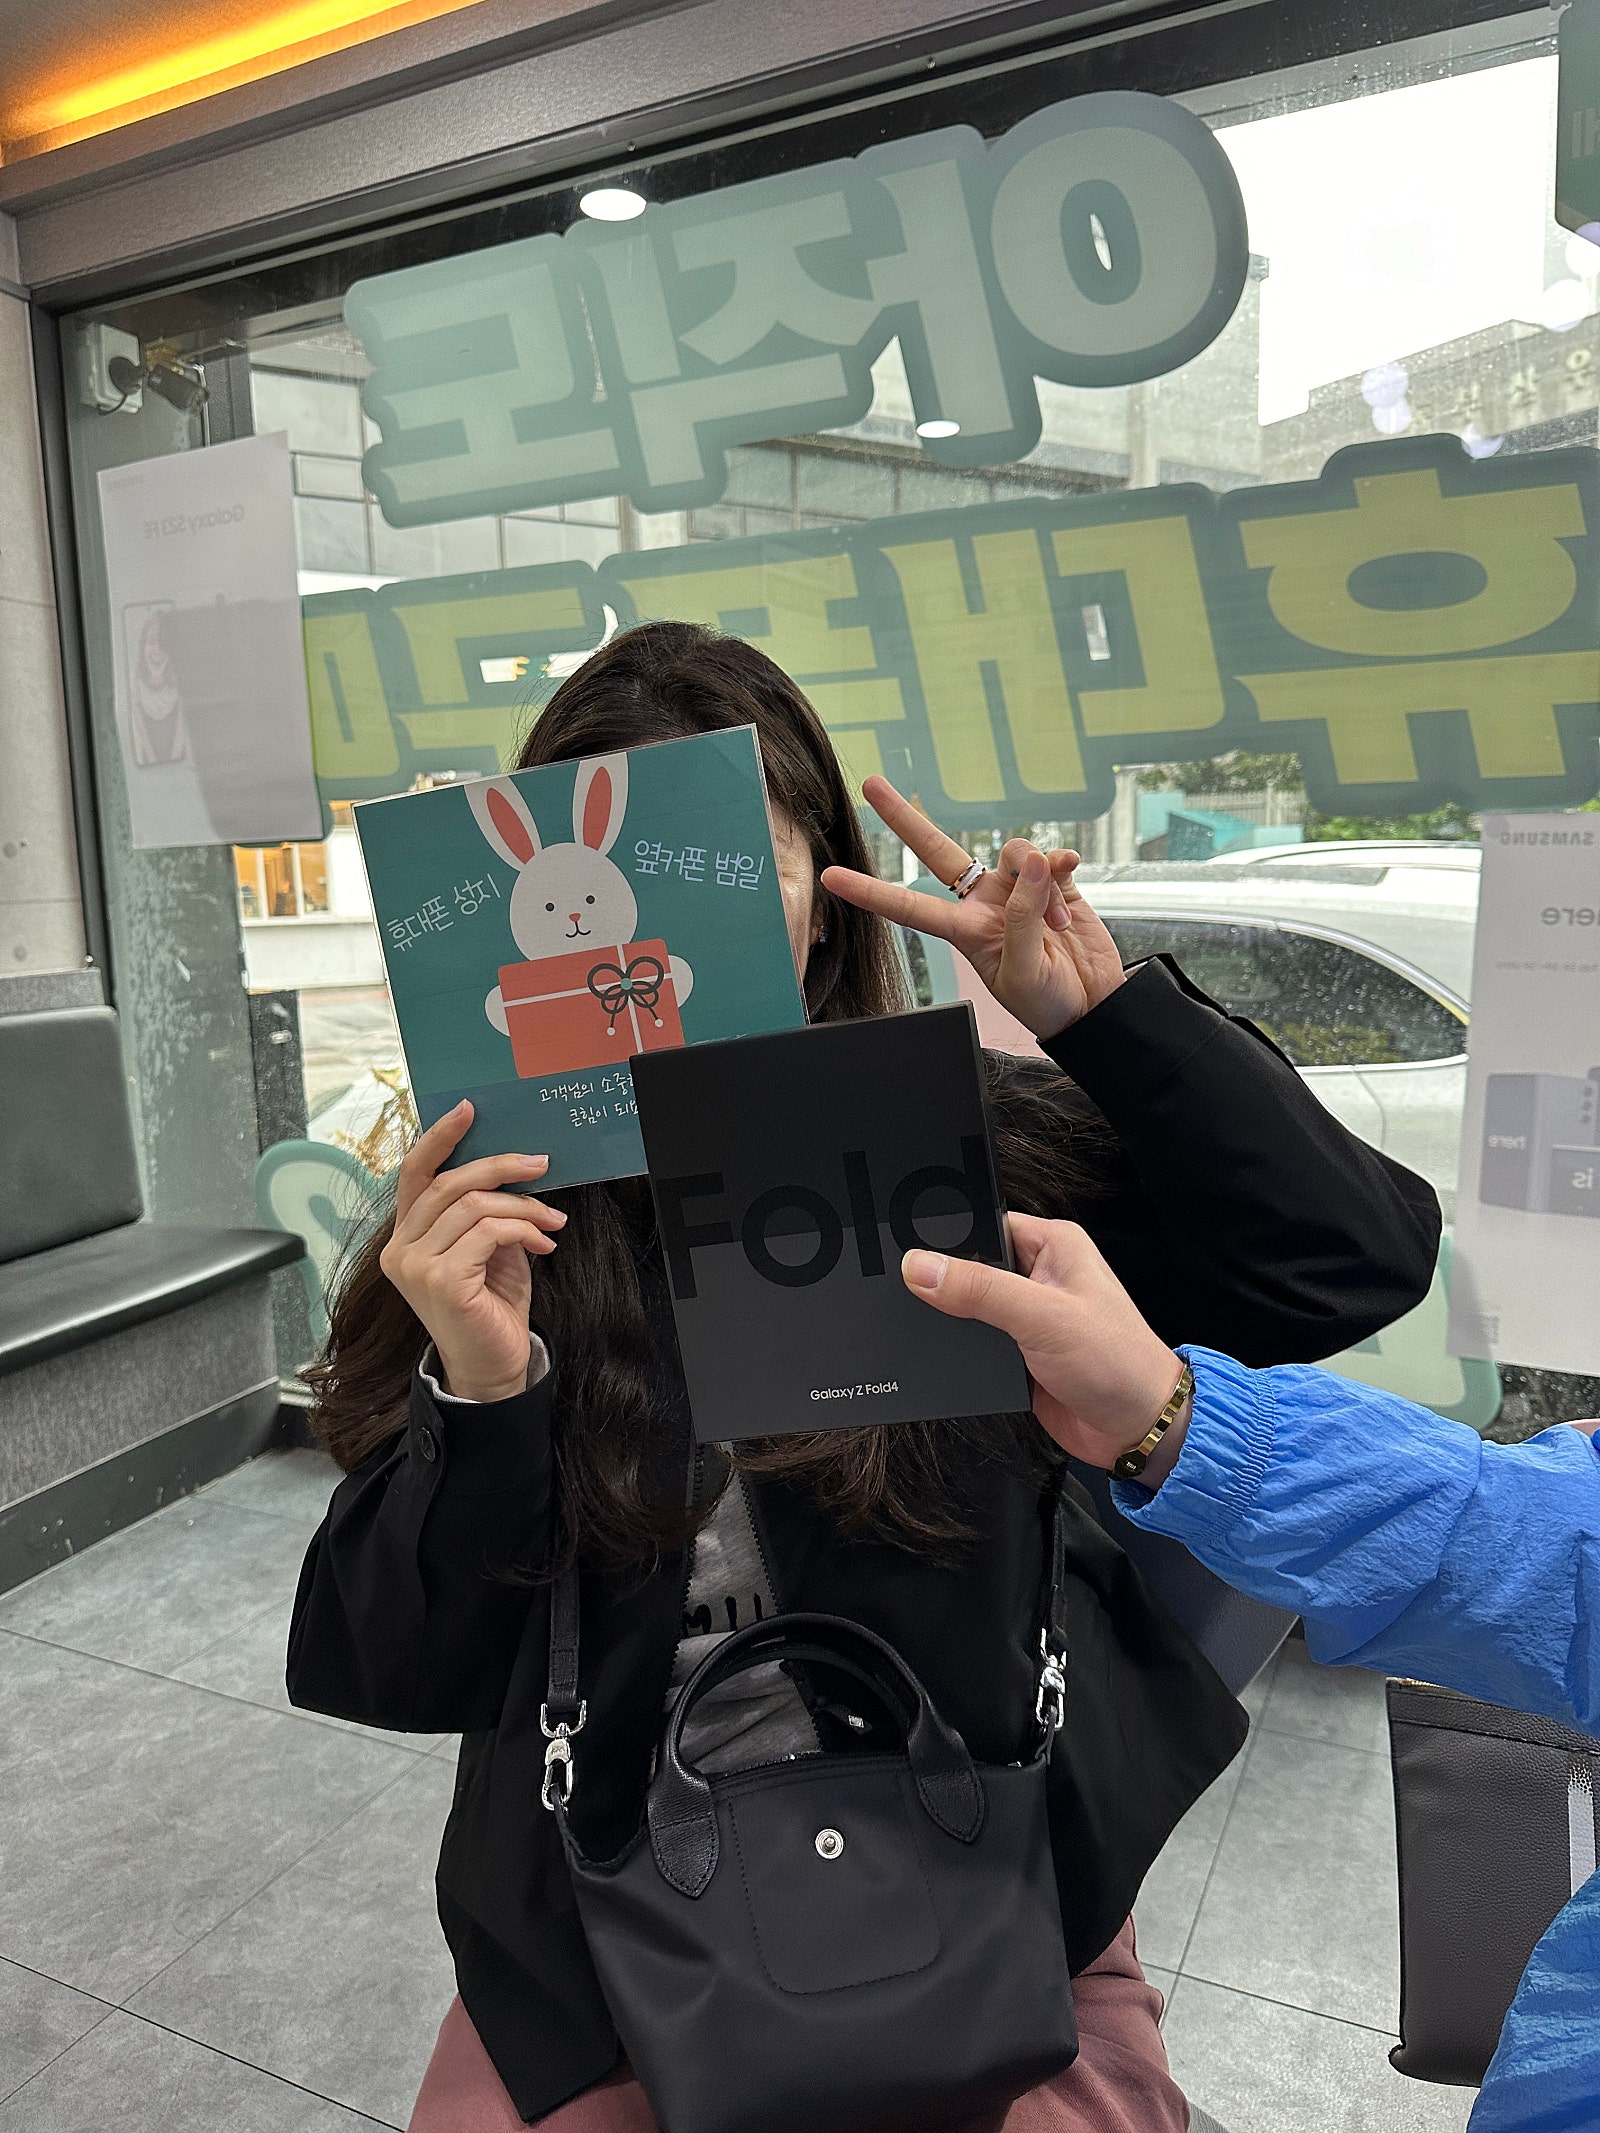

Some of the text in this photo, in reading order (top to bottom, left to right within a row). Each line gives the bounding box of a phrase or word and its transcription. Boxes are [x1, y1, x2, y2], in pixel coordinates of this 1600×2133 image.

[633, 839, 765, 891] 옆커폰 범일
[386, 873, 501, 952] 휴대폰 성지
[539, 1082, 594, 1102] 고객님의
[656, 1133, 1004, 1301] Fold
[810, 1381, 899, 1401] Galaxy Z Fold4
